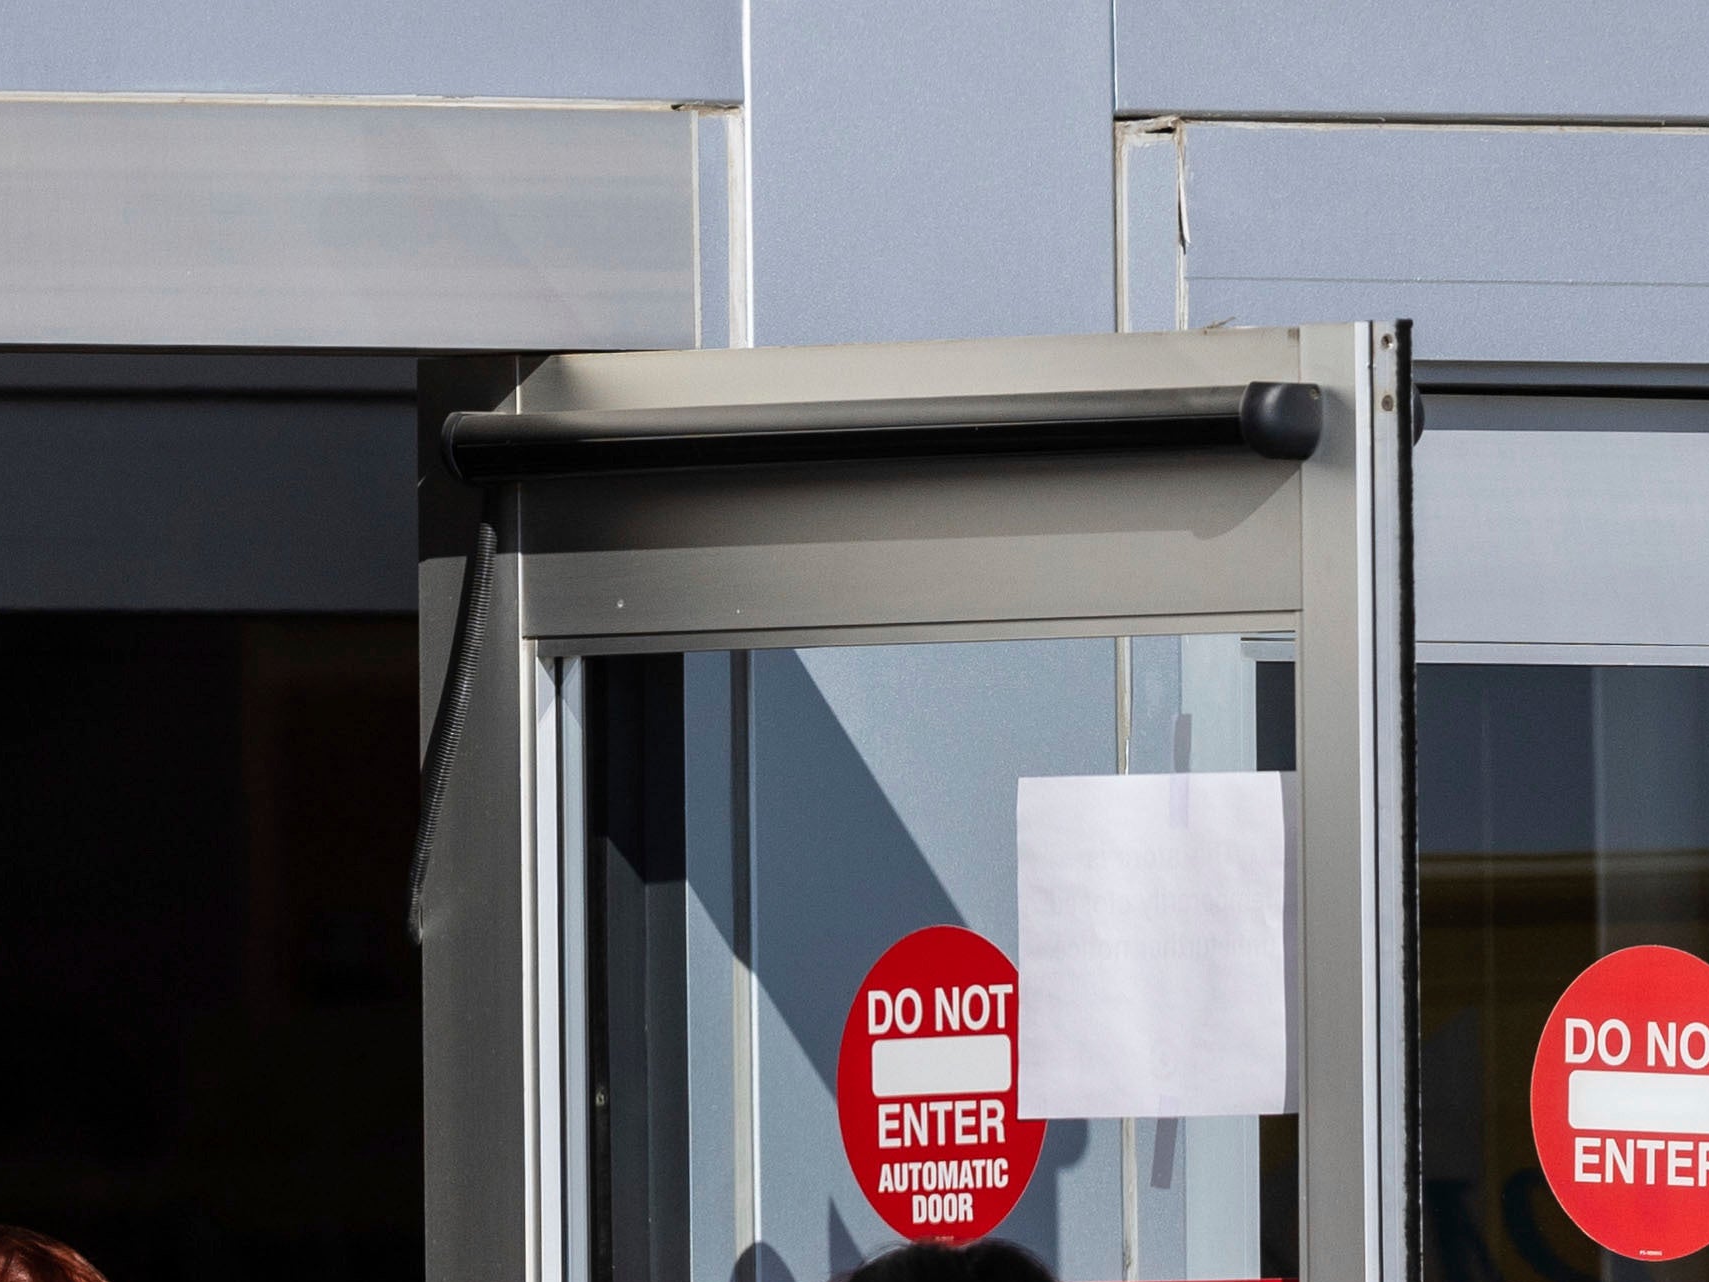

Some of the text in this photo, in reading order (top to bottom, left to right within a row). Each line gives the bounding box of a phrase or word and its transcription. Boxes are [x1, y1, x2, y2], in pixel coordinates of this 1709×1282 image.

[868, 984, 1013, 1035] DO NOT
[1565, 1016, 1632, 1066] DO
[878, 1100, 1005, 1148] ENTER
[878, 1158, 1008, 1192] AUTOMATIC
[912, 1193, 973, 1224] DOOR
